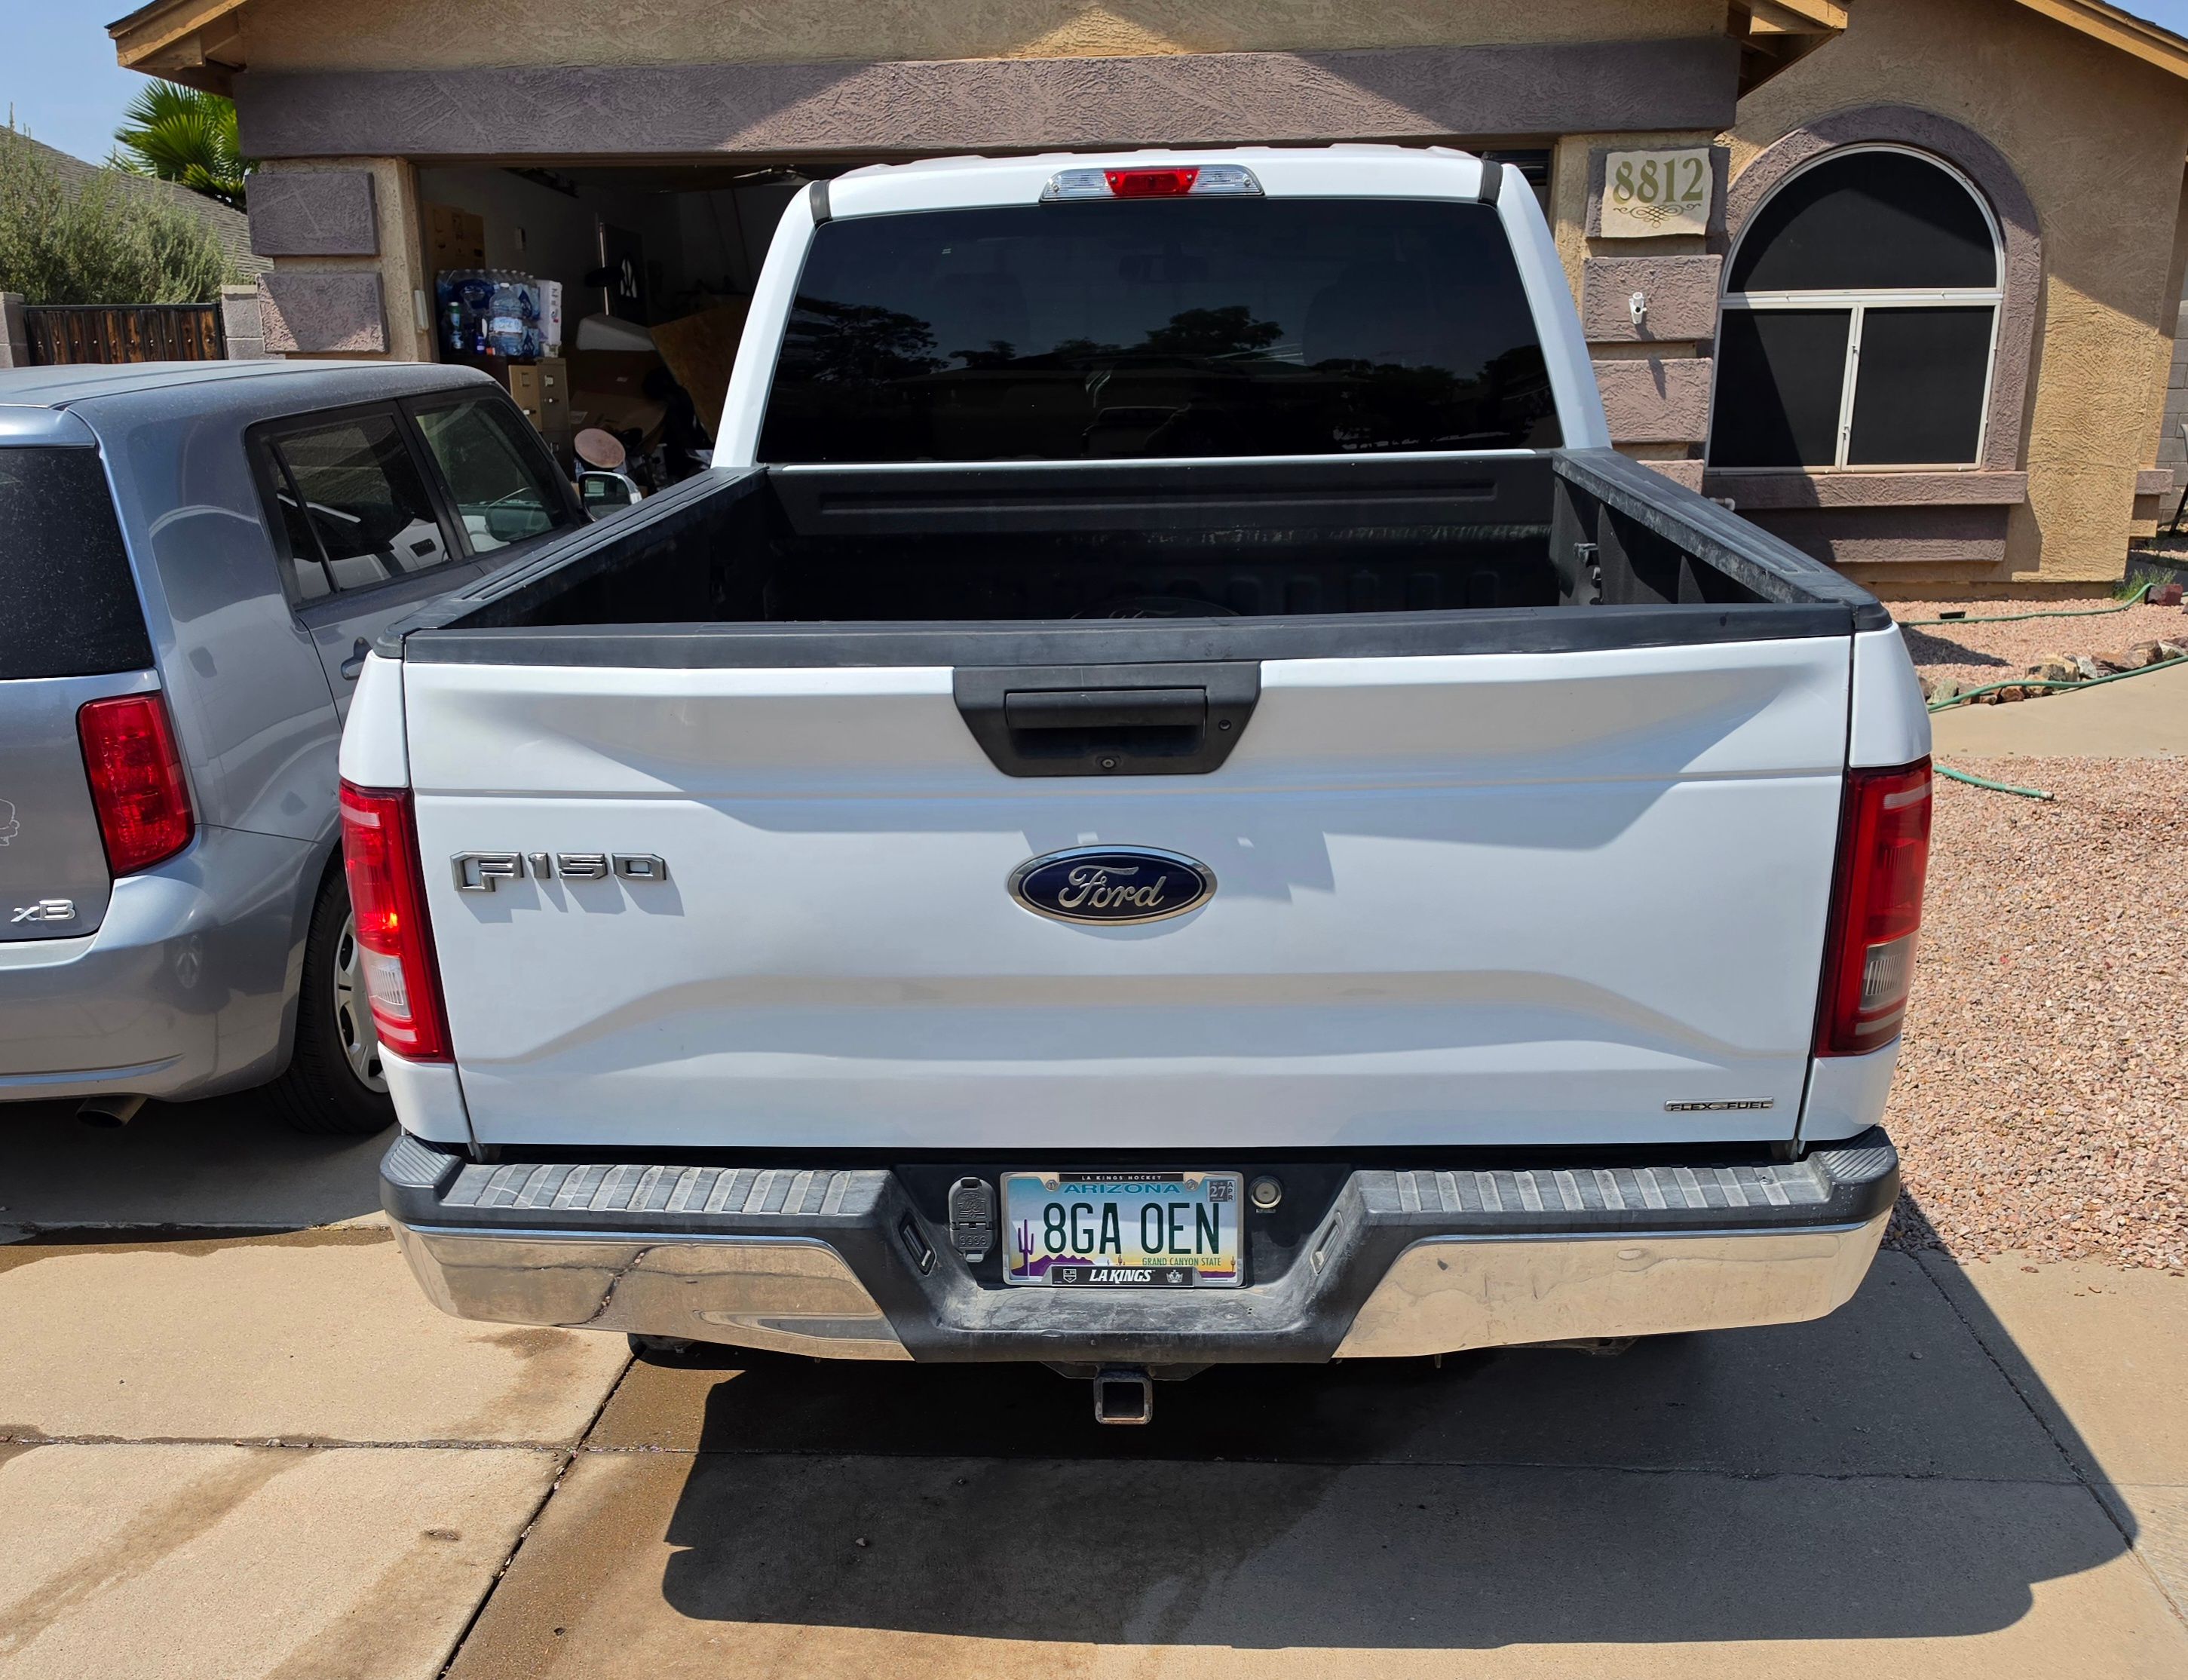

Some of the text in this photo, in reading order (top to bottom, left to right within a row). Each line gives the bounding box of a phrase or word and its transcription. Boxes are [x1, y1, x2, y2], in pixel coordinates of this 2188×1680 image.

[1613, 157, 1704, 204] 8812
[449, 850, 667, 892] F150
[1058, 864, 1167, 908] Ford
[11, 899, 75, 922] xB
[1670, 1101, 1770, 1111] FLEX FUEL
[1063, 1183, 1181, 1194] ARIZONA
[1209, 1185, 1226, 1197] 27
[1043, 1202, 1122, 1254] 8GA
[1142, 1257, 1221, 1266] GRAND CANYON STATE
[1089, 1269, 1152, 1284] LA KINGS
